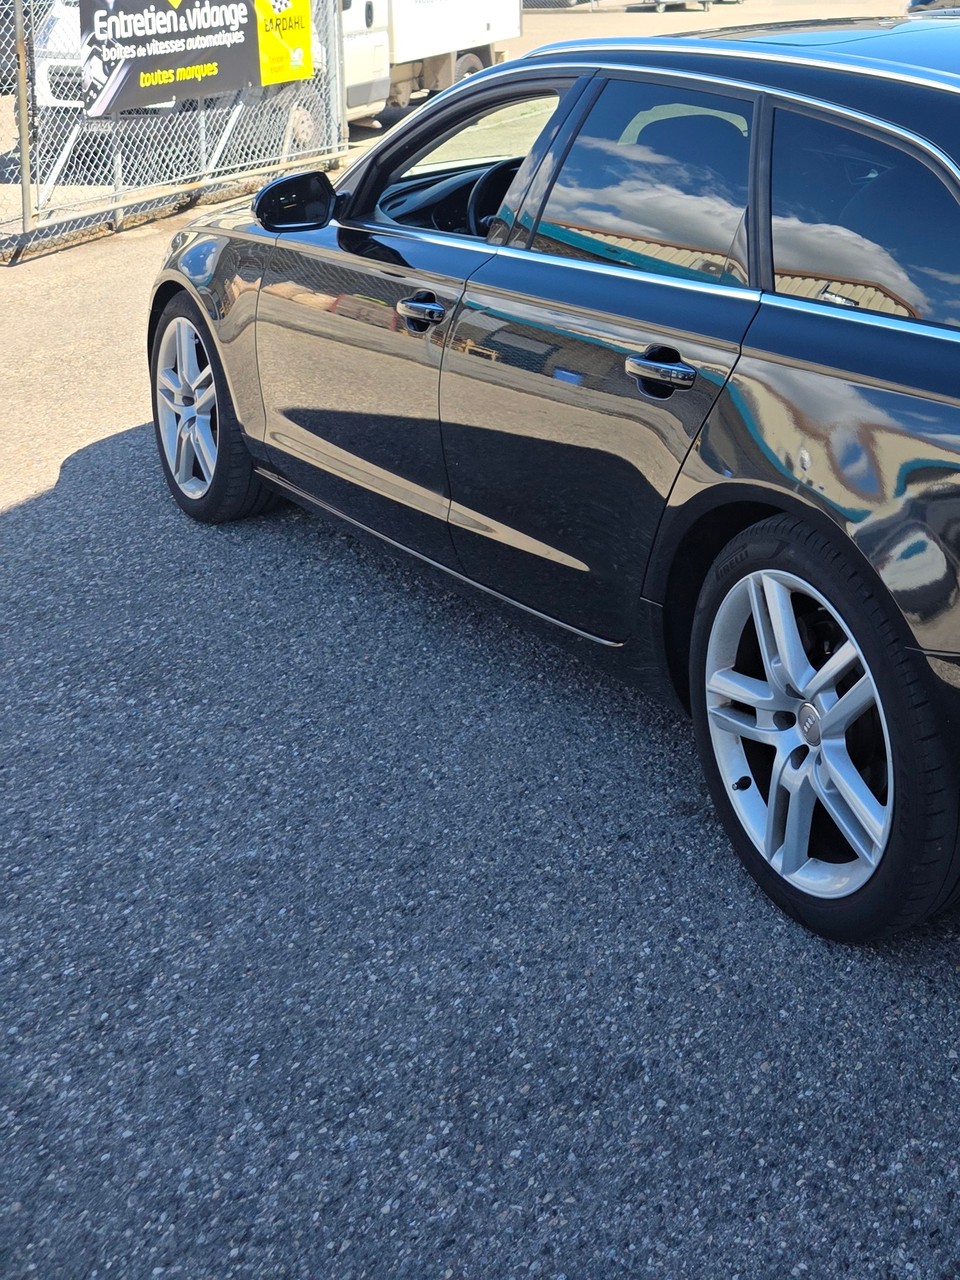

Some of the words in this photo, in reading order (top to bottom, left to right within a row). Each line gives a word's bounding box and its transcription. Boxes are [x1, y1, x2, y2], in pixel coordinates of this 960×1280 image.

[94, 8, 178, 41] Entretien
[187, 0, 249, 31] vidange
[264, 16, 306, 40] BARDAHL
[137, 45, 147, 58] de
[147, 38, 186, 56] vitesses
[186, 30, 246, 51] automatiques
[139, 68, 175, 88] toutes
[176, 61, 218, 81] marques
